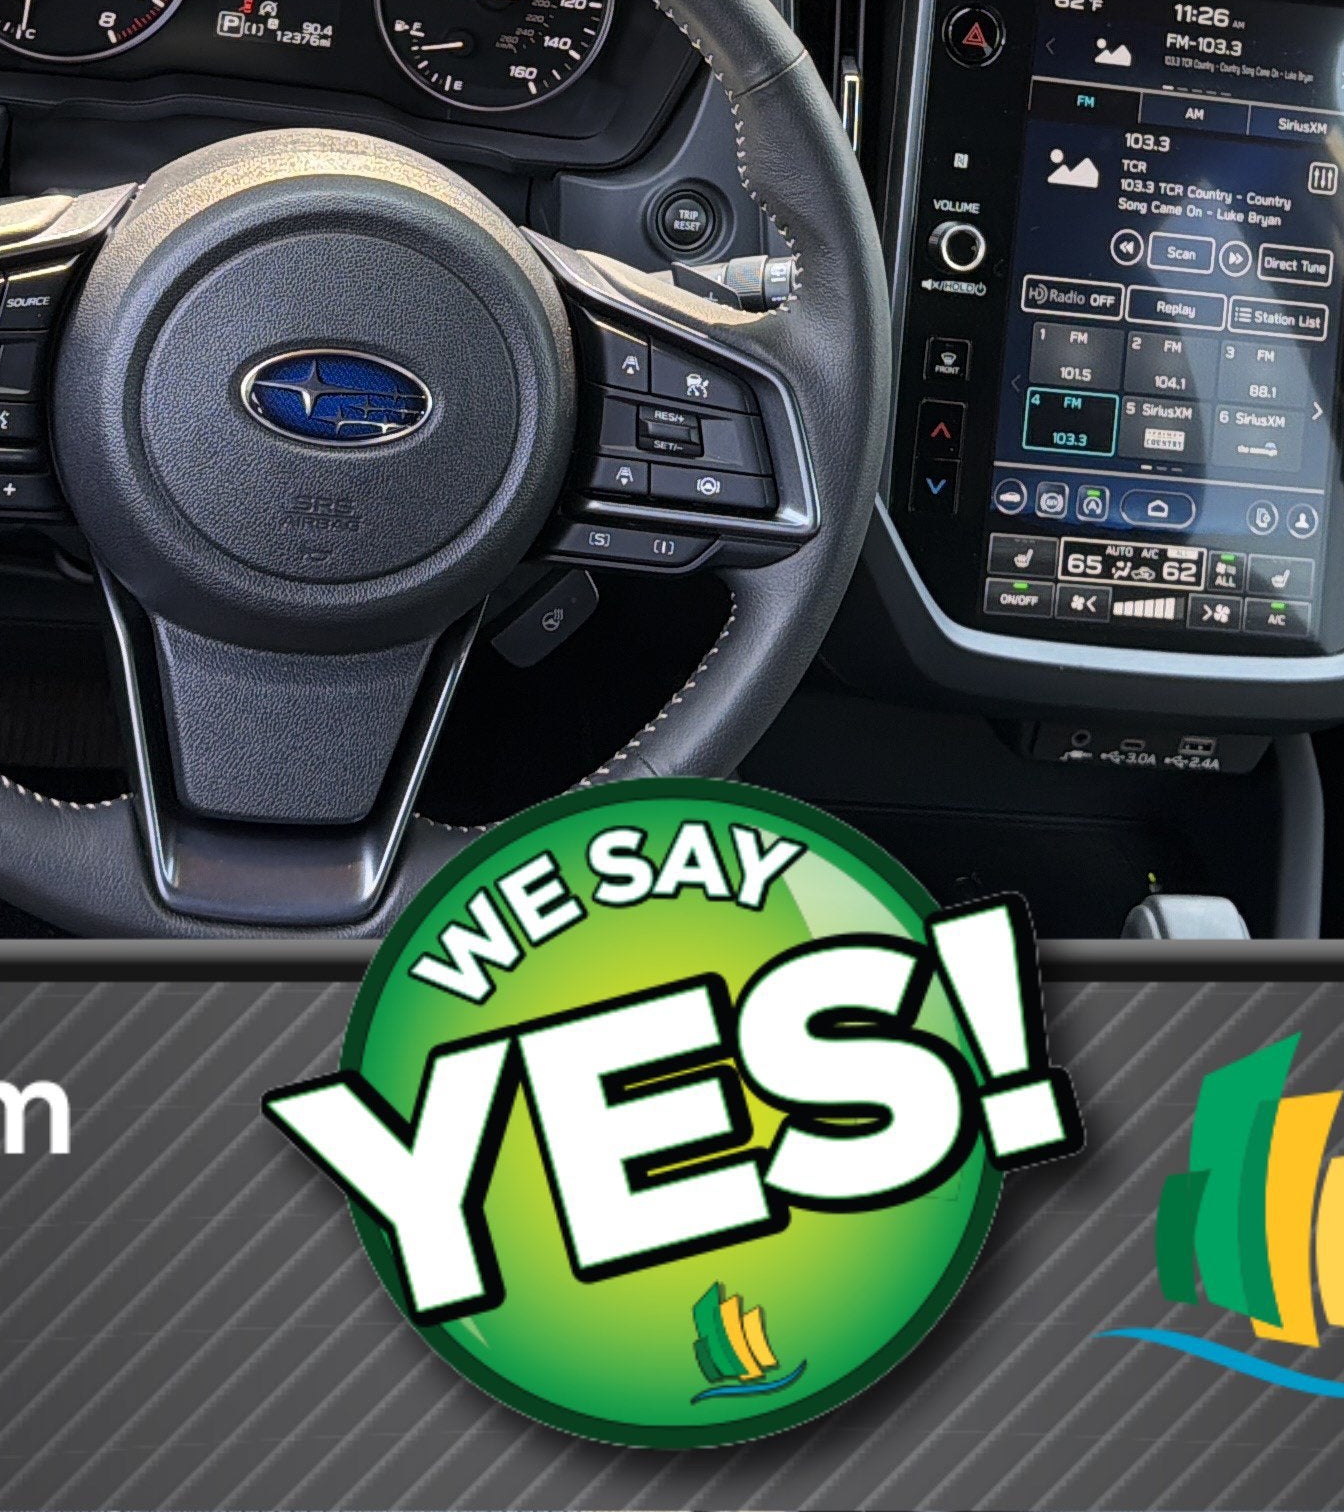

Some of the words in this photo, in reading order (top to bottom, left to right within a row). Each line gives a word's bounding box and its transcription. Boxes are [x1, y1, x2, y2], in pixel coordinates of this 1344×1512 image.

[532, 0, 550, 8] 200
[99, 11, 116, 27] 8
[223, 15, 239, 31] P
[526, 14, 544, 23] 220
[1174, 4, 1229, 27] 11:26
[1232, 20, 1246, 29] AM
[303, 22, 332, 36] 90.4
[544, 37, 571, 50] 140
[1166, 33, 1242, 57] FM-103.3
[509, 66, 537, 79] 160
[1164, 55, 1180, 66] 103.3
[1194, 59, 1214, 73] Country
[1220, 61, 1240, 75] Country
[1242, 65, 1255, 77] Song
[1256, 66, 1270, 77] Came
[1285, 70, 1297, 80] Luke
[1298, 71, 1314, 84] Bryan
[453, 81, 463, 90] E
[1076, 95, 1095, 108] FM
[1185, 107, 1204, 120] AM
[1278, 118, 1328, 134] SiriusXM
[1125, 132, 1170, 152] 103.3
[1122, 159, 1147, 173] TCR
[1120, 178, 1154, 194] 103.3
[1158, 182, 1183, 196] TCR
[1187, 186, 1232, 205] Country
[1246, 192, 1292, 211] Country
[679, 209, 698, 220] TRIP
[933, 198, 980, 215] VOLUME
[1118, 197, 1147, 214] Song
[1151, 201, 1182, 216] Came
[1186, 204, 1203, 218] On
[1217, 208, 1244, 223] Luke
[1248, 212, 1282, 228] Bryan
[673, 220, 702, 231] RESET
[1167, 246, 1196, 261] Scan
[1264, 257, 1297, 272] Direct
[1301, 259, 1326, 275] Tune
[6, 296, 50, 308] SOURCE
[1049, 289, 1085, 305] Radio
[1090, 294, 1115, 307] OFF
[1157, 300, 1196, 319] Replay
[1254, 310, 1295, 326] Station
[1299, 314, 1321, 329] List
[1040, 328, 1046, 340] 1
[1070, 331, 1088, 345] FM
[1131, 338, 1141, 350] 2
[1164, 340, 1182, 354] FM
[1225, 347, 1235, 360] 3
[1257, 349, 1275, 363] FM
[935, 364, 960, 375] FRONT
[1060, 366, 1092, 382] 101.5
[1155, 376, 1186, 391] 104.1
[1249, 384, 1276, 399] 88.1
[1031, 394, 1040, 406] 4
[1064, 397, 1082, 410] FM
[654, 410, 684, 423] RES/+
[1126, 402, 1136, 415] 5
[1142, 404, 1192, 421] SiriusXM
[1219, 412, 1229, 424] 6
[1235, 412, 1286, 429] SiriusXM
[1053, 432, 1087, 447] 103.3
[293, 495, 356, 515] SRS
[278, 515, 360, 531] AIRBAG
[1106, 545, 1133, 557] AUTO
[1141, 548, 1159, 560] A/C
[1067, 553, 1102, 575] 65
[1162, 561, 1196, 582] 62
[1215, 575, 1235, 588] ALL
[1000, 593, 1038, 607] ON/OFF
[1267, 613, 1286, 626] A/C
[1126, 752, 1156, 766] 3.0A
[1188, 757, 1219, 771] 2.4A
